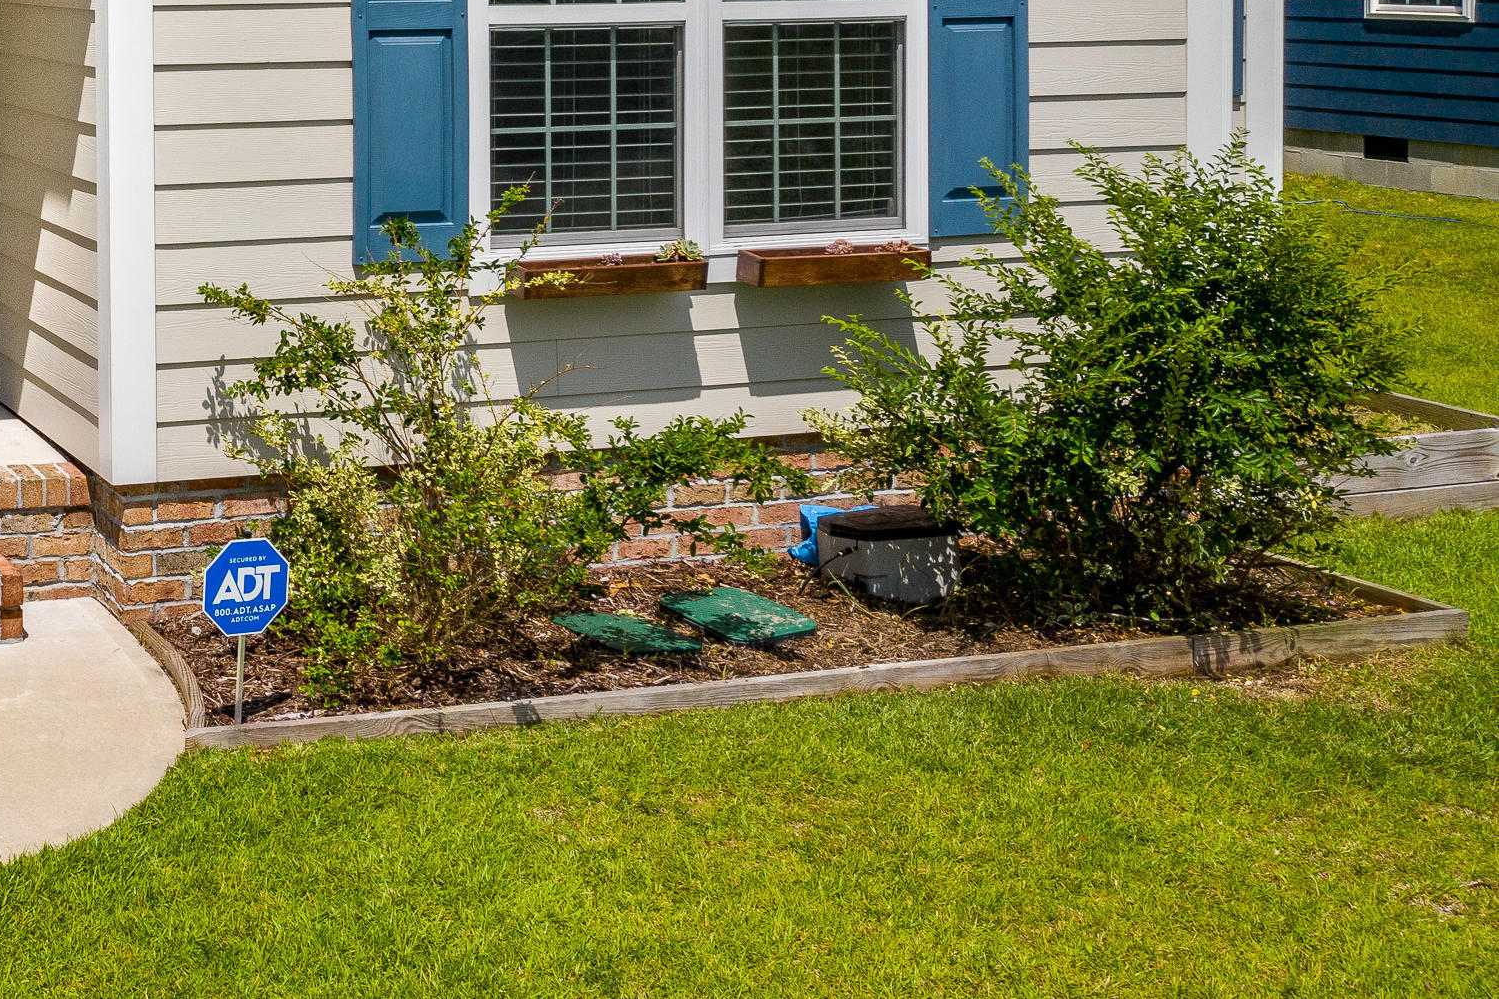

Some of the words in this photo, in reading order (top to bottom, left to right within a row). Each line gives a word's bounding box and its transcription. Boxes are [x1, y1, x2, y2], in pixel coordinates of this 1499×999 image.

[212, 564, 280, 604] ADT
[214, 604, 276, 616] 800.ADT.ASAP
[230, 615, 259, 623] ADT.COM
